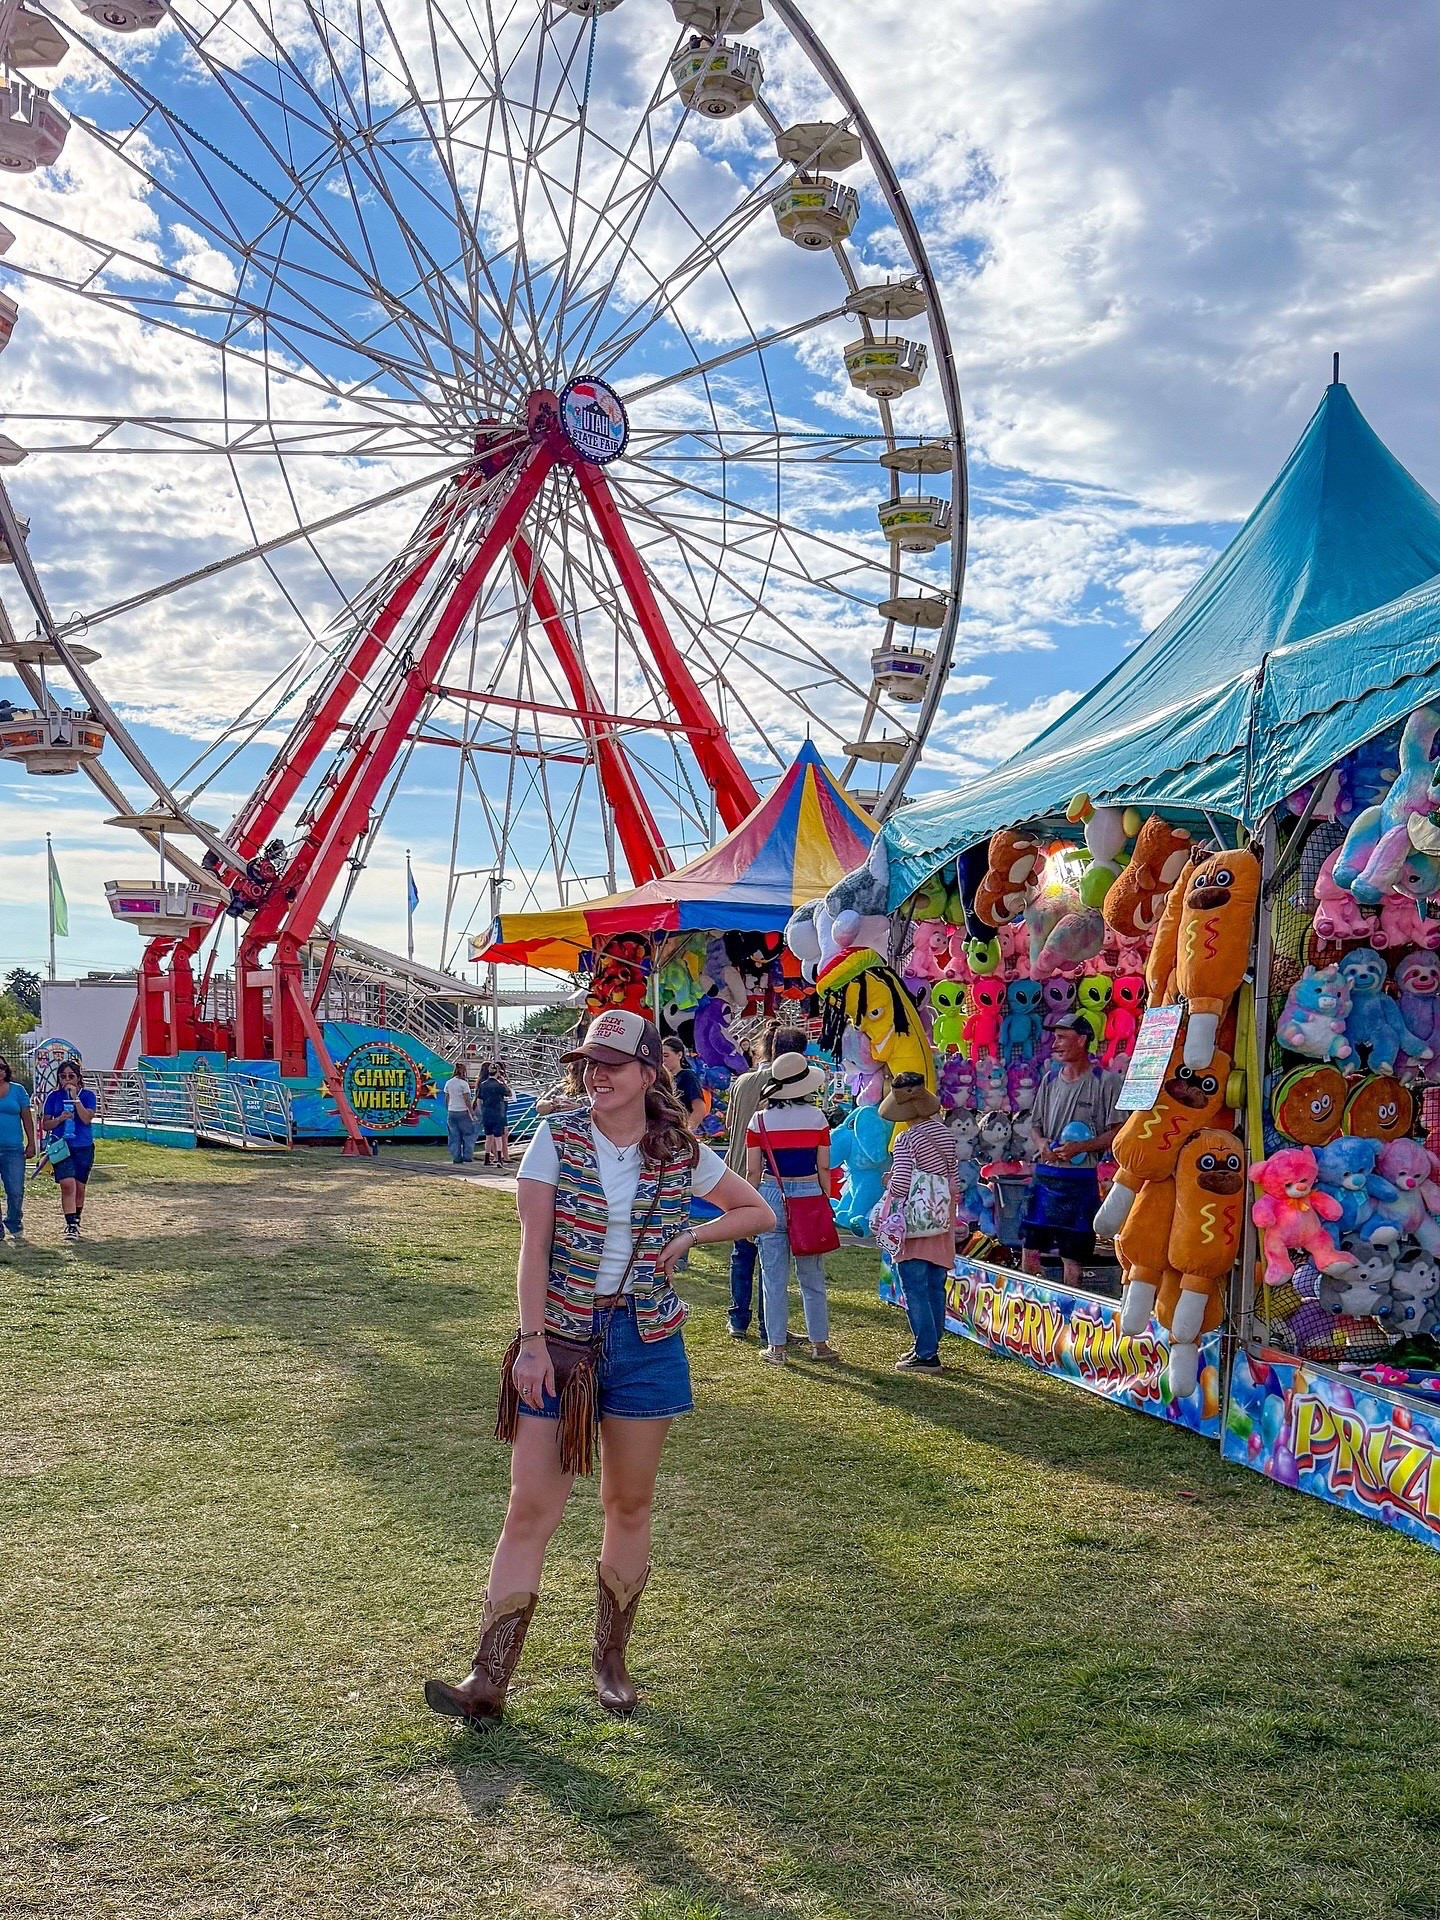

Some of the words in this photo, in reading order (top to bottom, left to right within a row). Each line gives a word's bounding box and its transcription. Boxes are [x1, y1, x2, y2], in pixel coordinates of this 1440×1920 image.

[583, 410, 609, 436] UTAH
[572, 429, 599, 446] STATE
[600, 439, 619, 451] FAIR
[369, 1053, 389, 1065] THE
[353, 1068, 406, 1087] GIANT
[352, 1090, 408, 1109] WHEEL
[974, 1284, 1063, 1366] EVERY
[1071, 1312, 1168, 1402] TIME!
